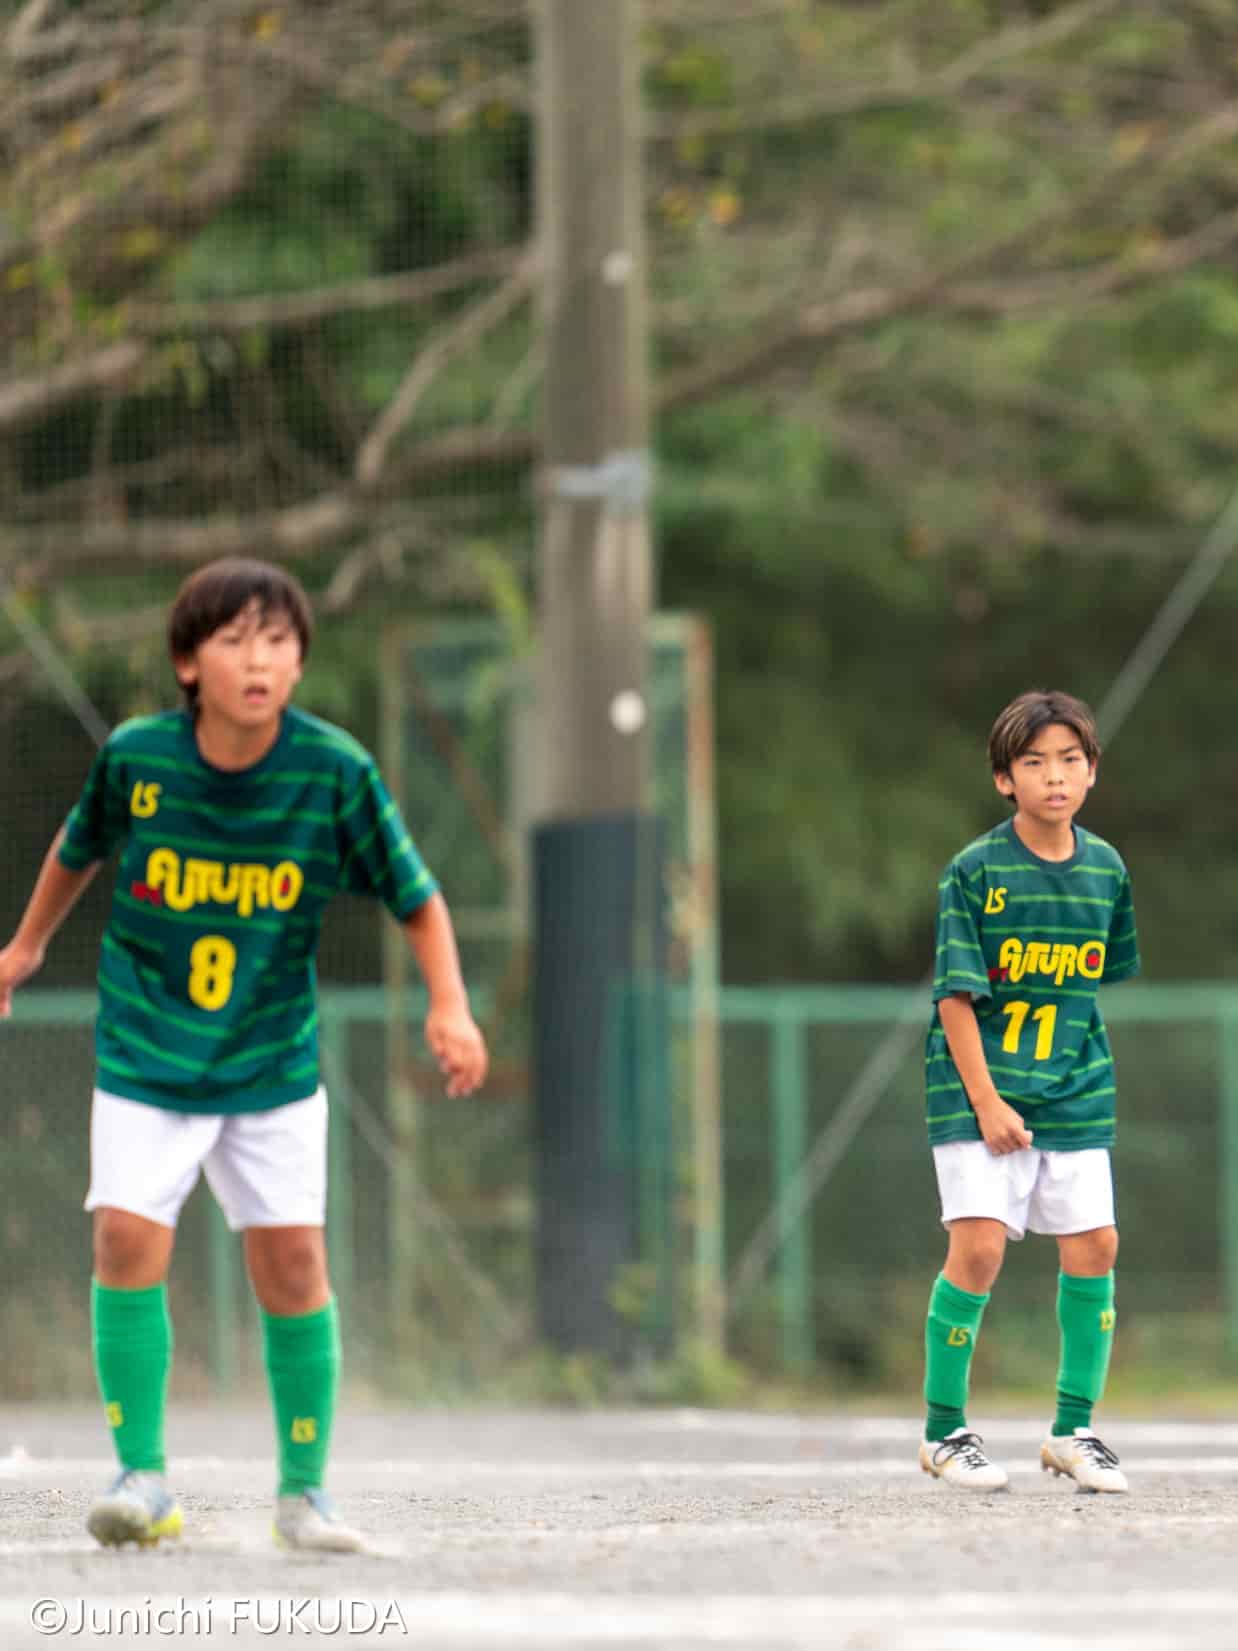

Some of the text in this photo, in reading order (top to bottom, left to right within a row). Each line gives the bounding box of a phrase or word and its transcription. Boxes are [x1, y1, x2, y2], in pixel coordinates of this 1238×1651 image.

[983, 887, 1008, 915] LS
[188, 934, 236, 1012] 8
[1002, 1001, 1057, 1061] 11
